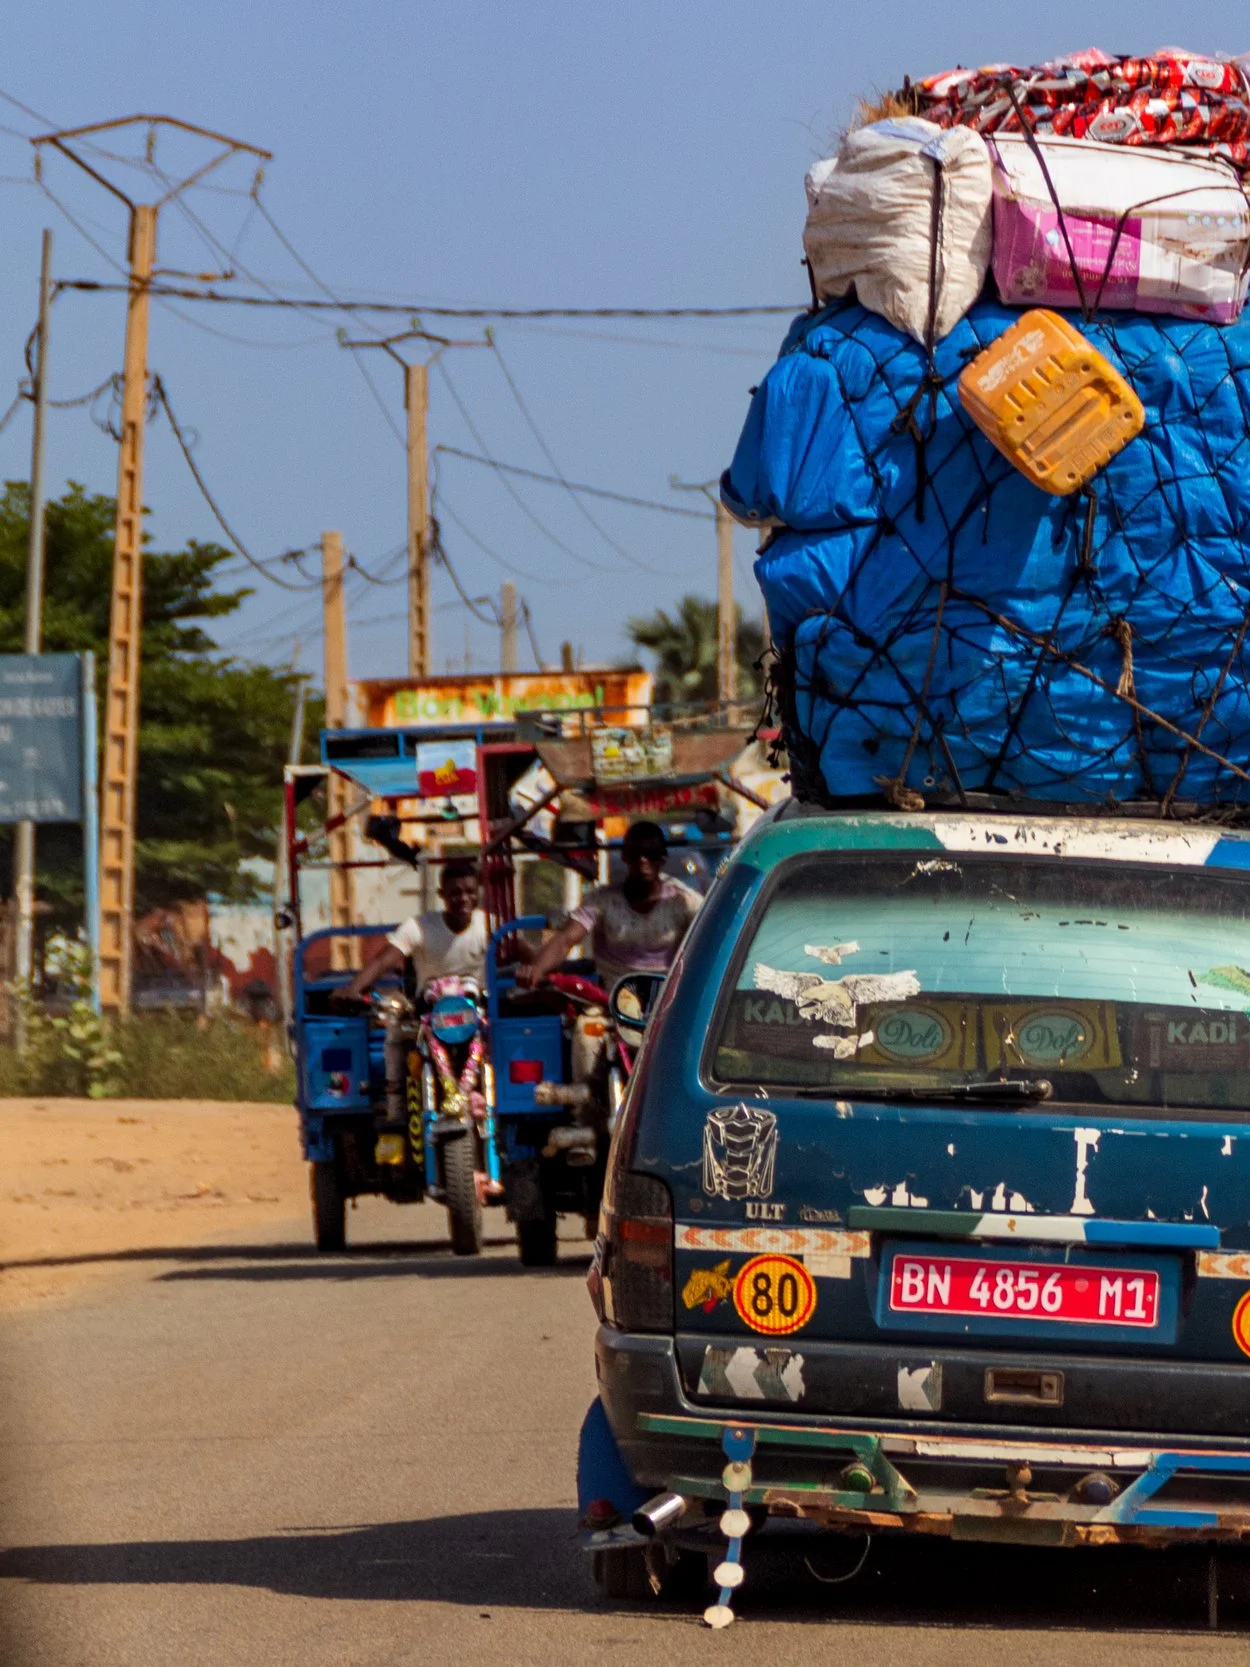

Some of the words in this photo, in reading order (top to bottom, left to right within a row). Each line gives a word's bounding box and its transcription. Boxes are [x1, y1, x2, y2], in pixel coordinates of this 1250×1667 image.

[745, 1202, 786, 1221] ULT
[752, 1272, 799, 1317] 80
[901, 1263, 951, 1306] BN
[968, 1267, 1063, 1313] 4856
[1098, 1275, 1148, 1319] M1
